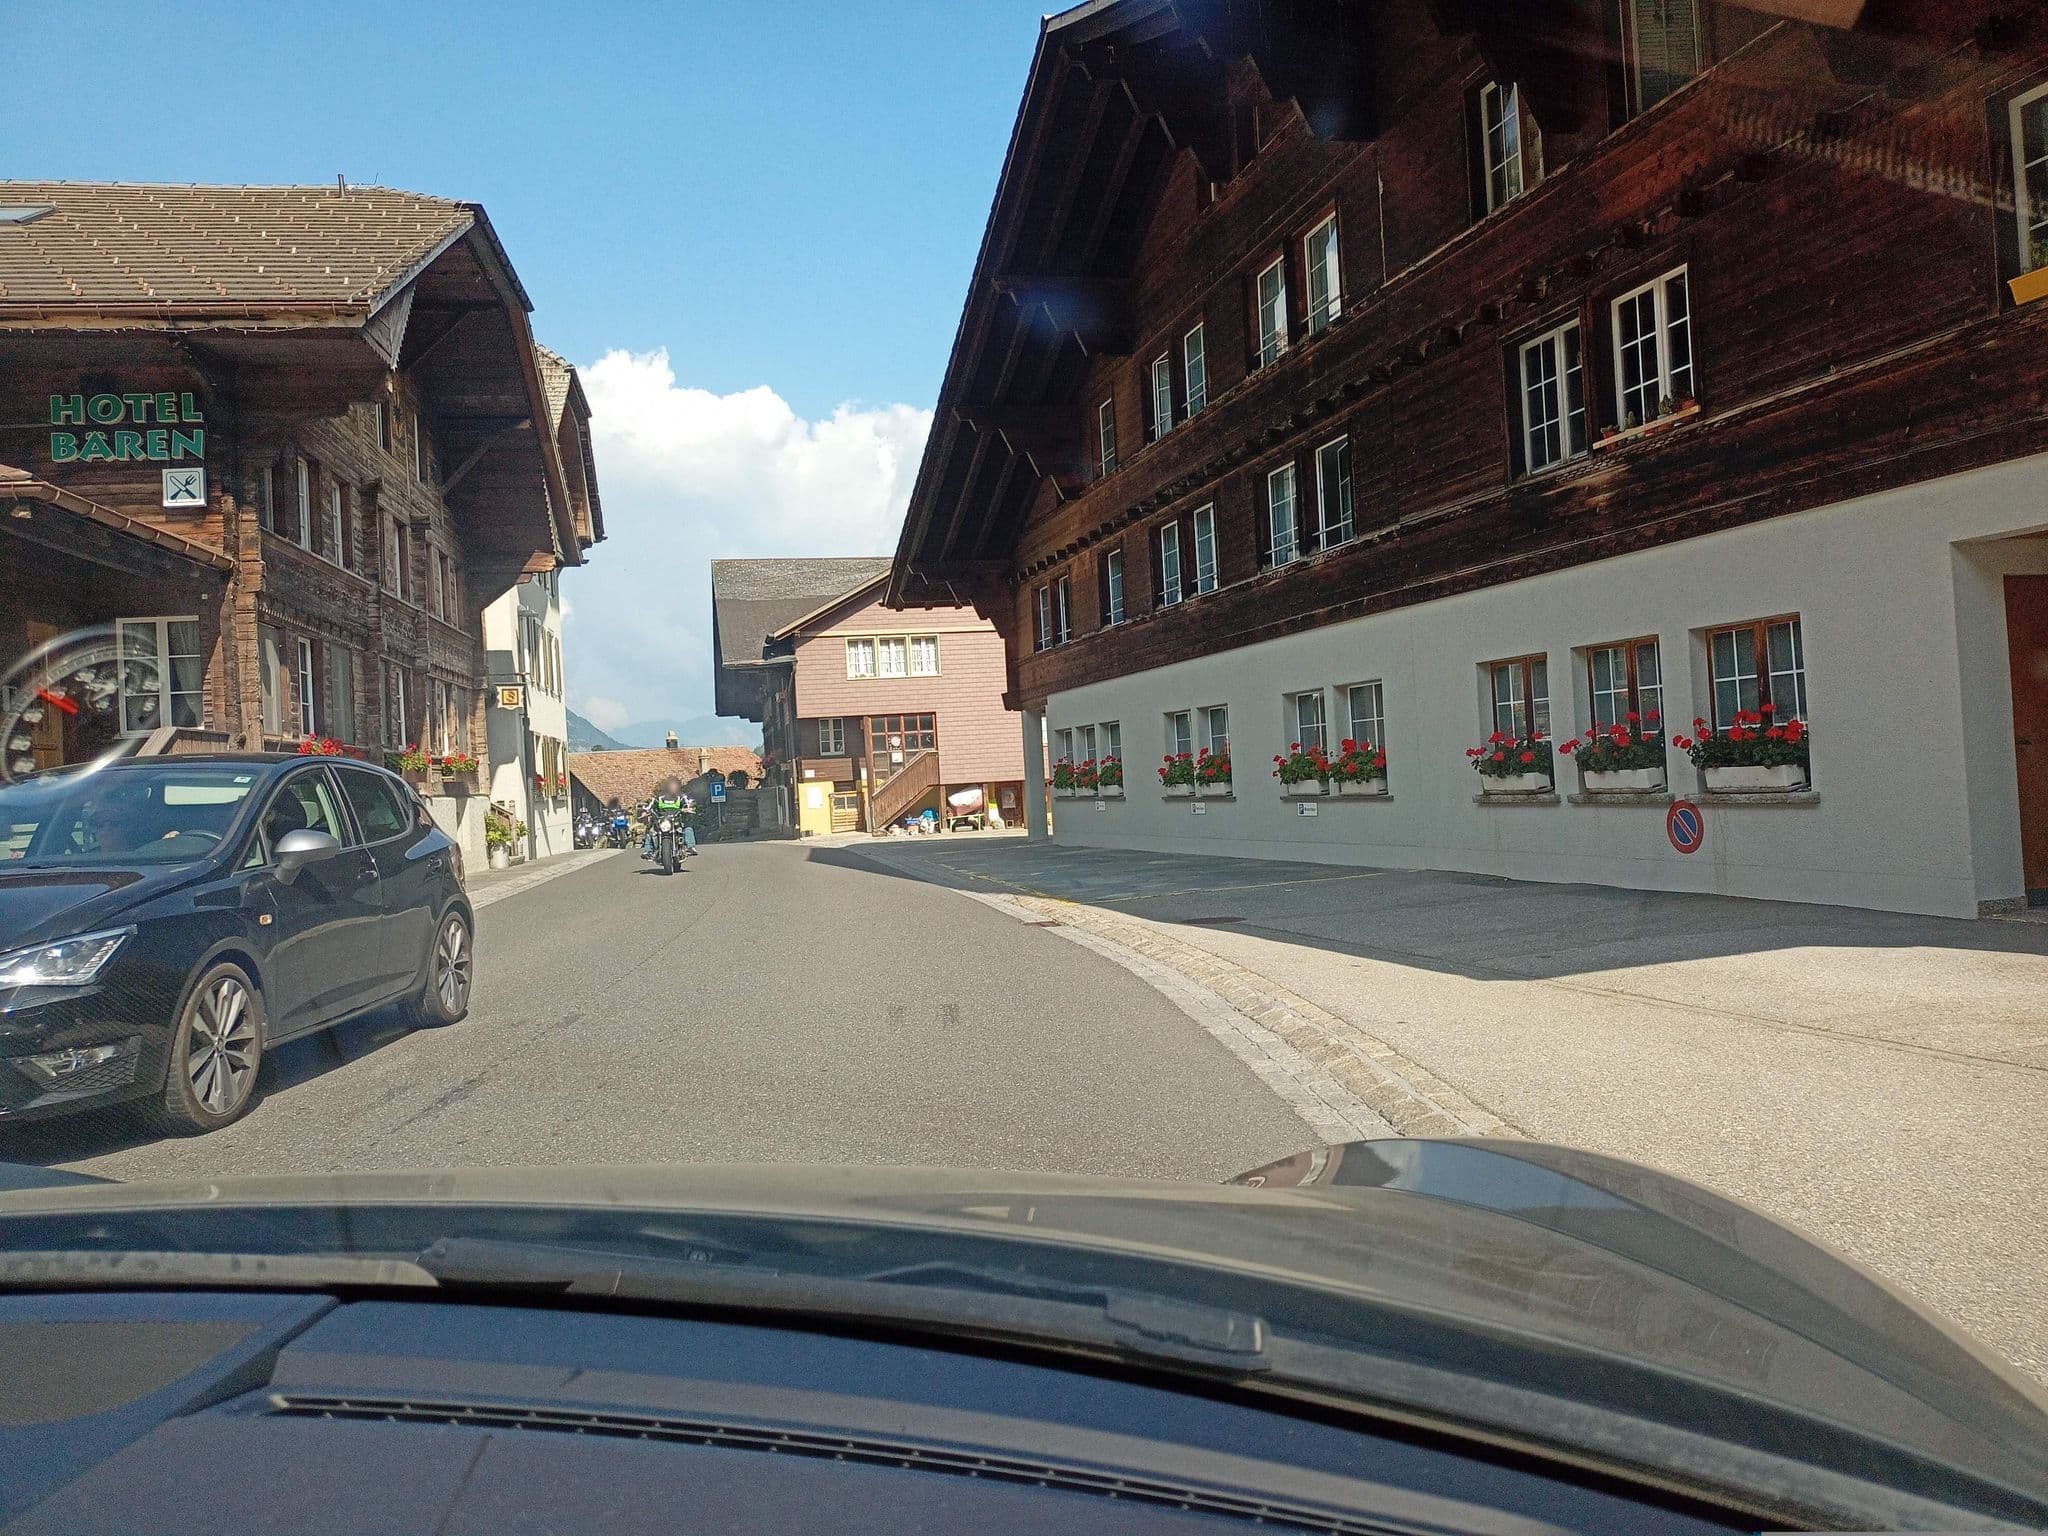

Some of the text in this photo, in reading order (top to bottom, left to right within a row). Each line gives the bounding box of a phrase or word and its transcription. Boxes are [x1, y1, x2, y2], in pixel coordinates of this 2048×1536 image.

[50, 392, 204, 425] HOTEL
[50, 429, 205, 463] BÄREN
[714, 784, 722, 796] P
